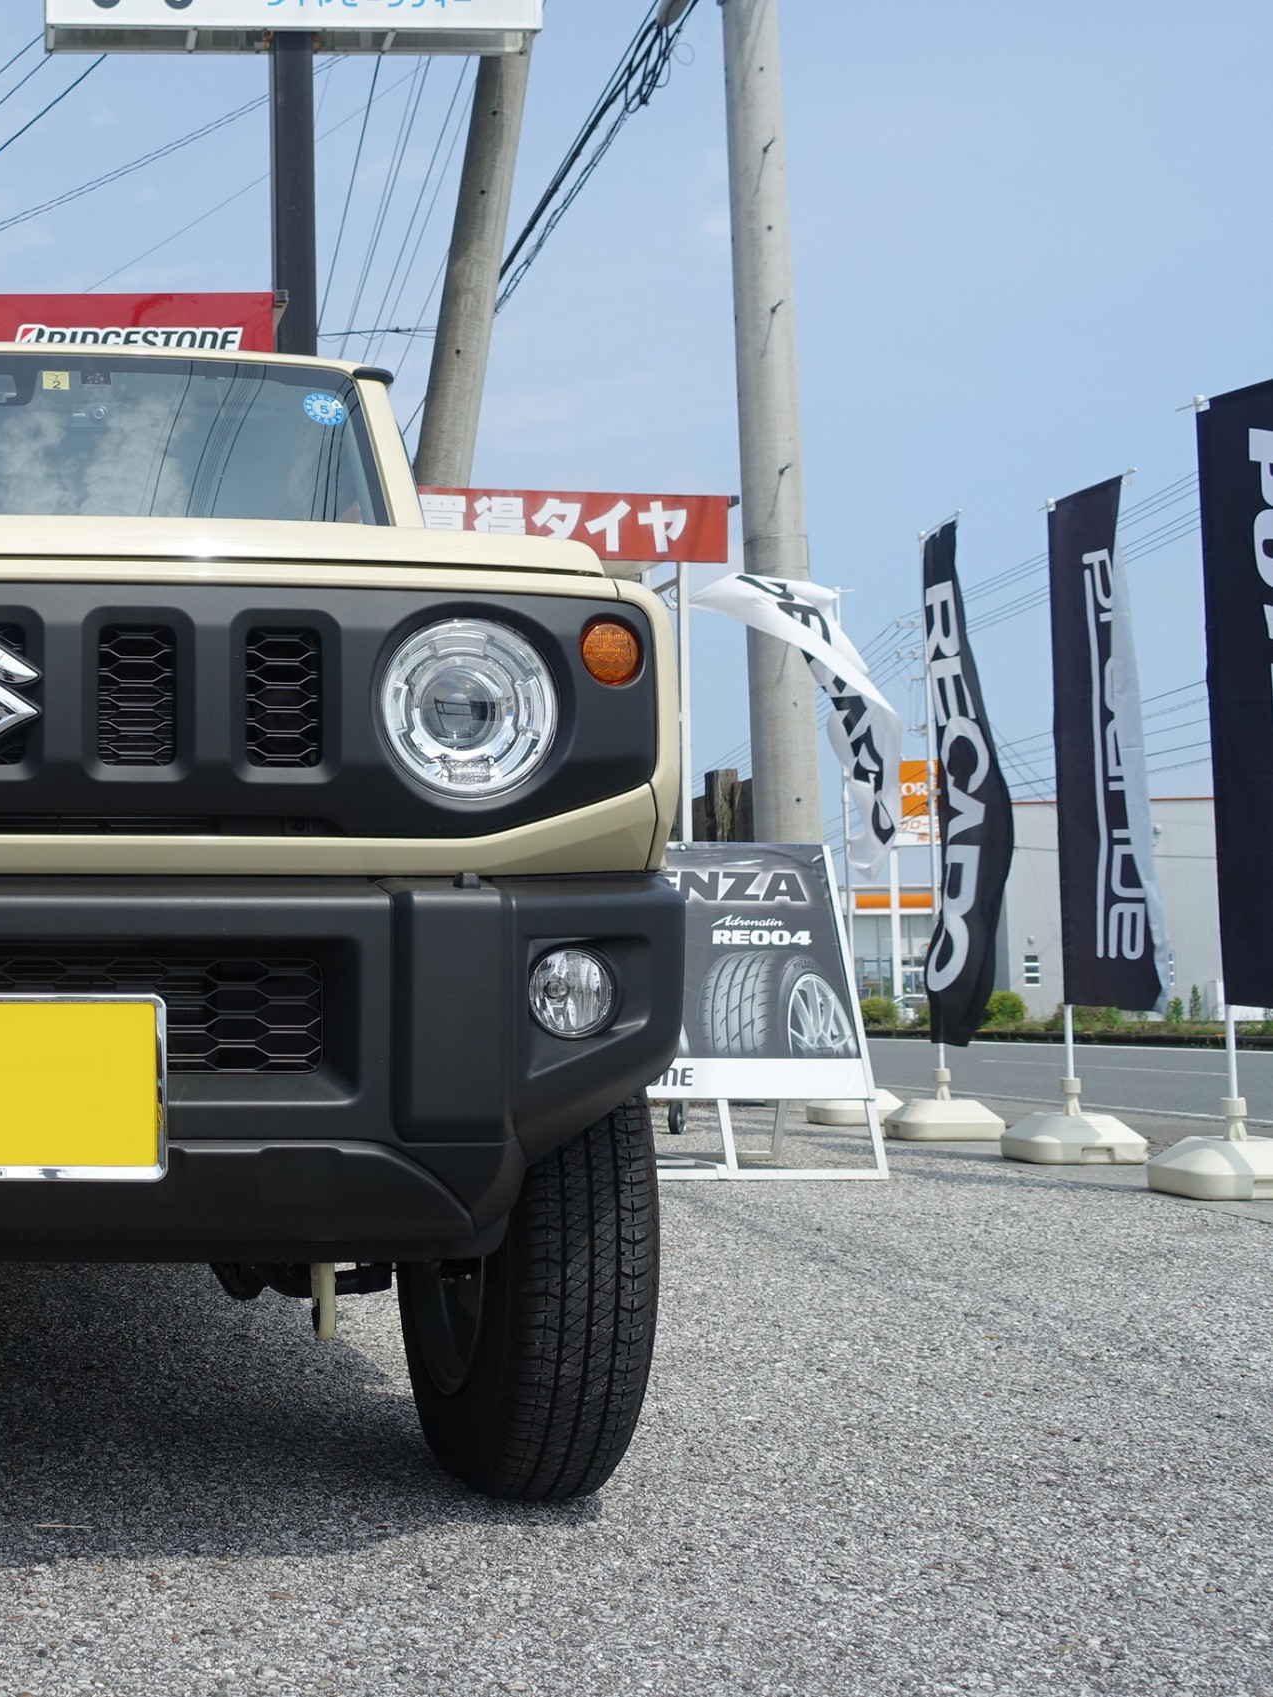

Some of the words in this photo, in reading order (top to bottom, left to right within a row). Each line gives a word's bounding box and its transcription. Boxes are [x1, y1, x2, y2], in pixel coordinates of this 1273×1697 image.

[52, 380, 61, 389] 2
[320, 404, 330, 415] 5
[925, 580, 990, 992] RECARO
[711, 914, 784, 928] Adrenalin
[712, 930, 812, 946] RE004
